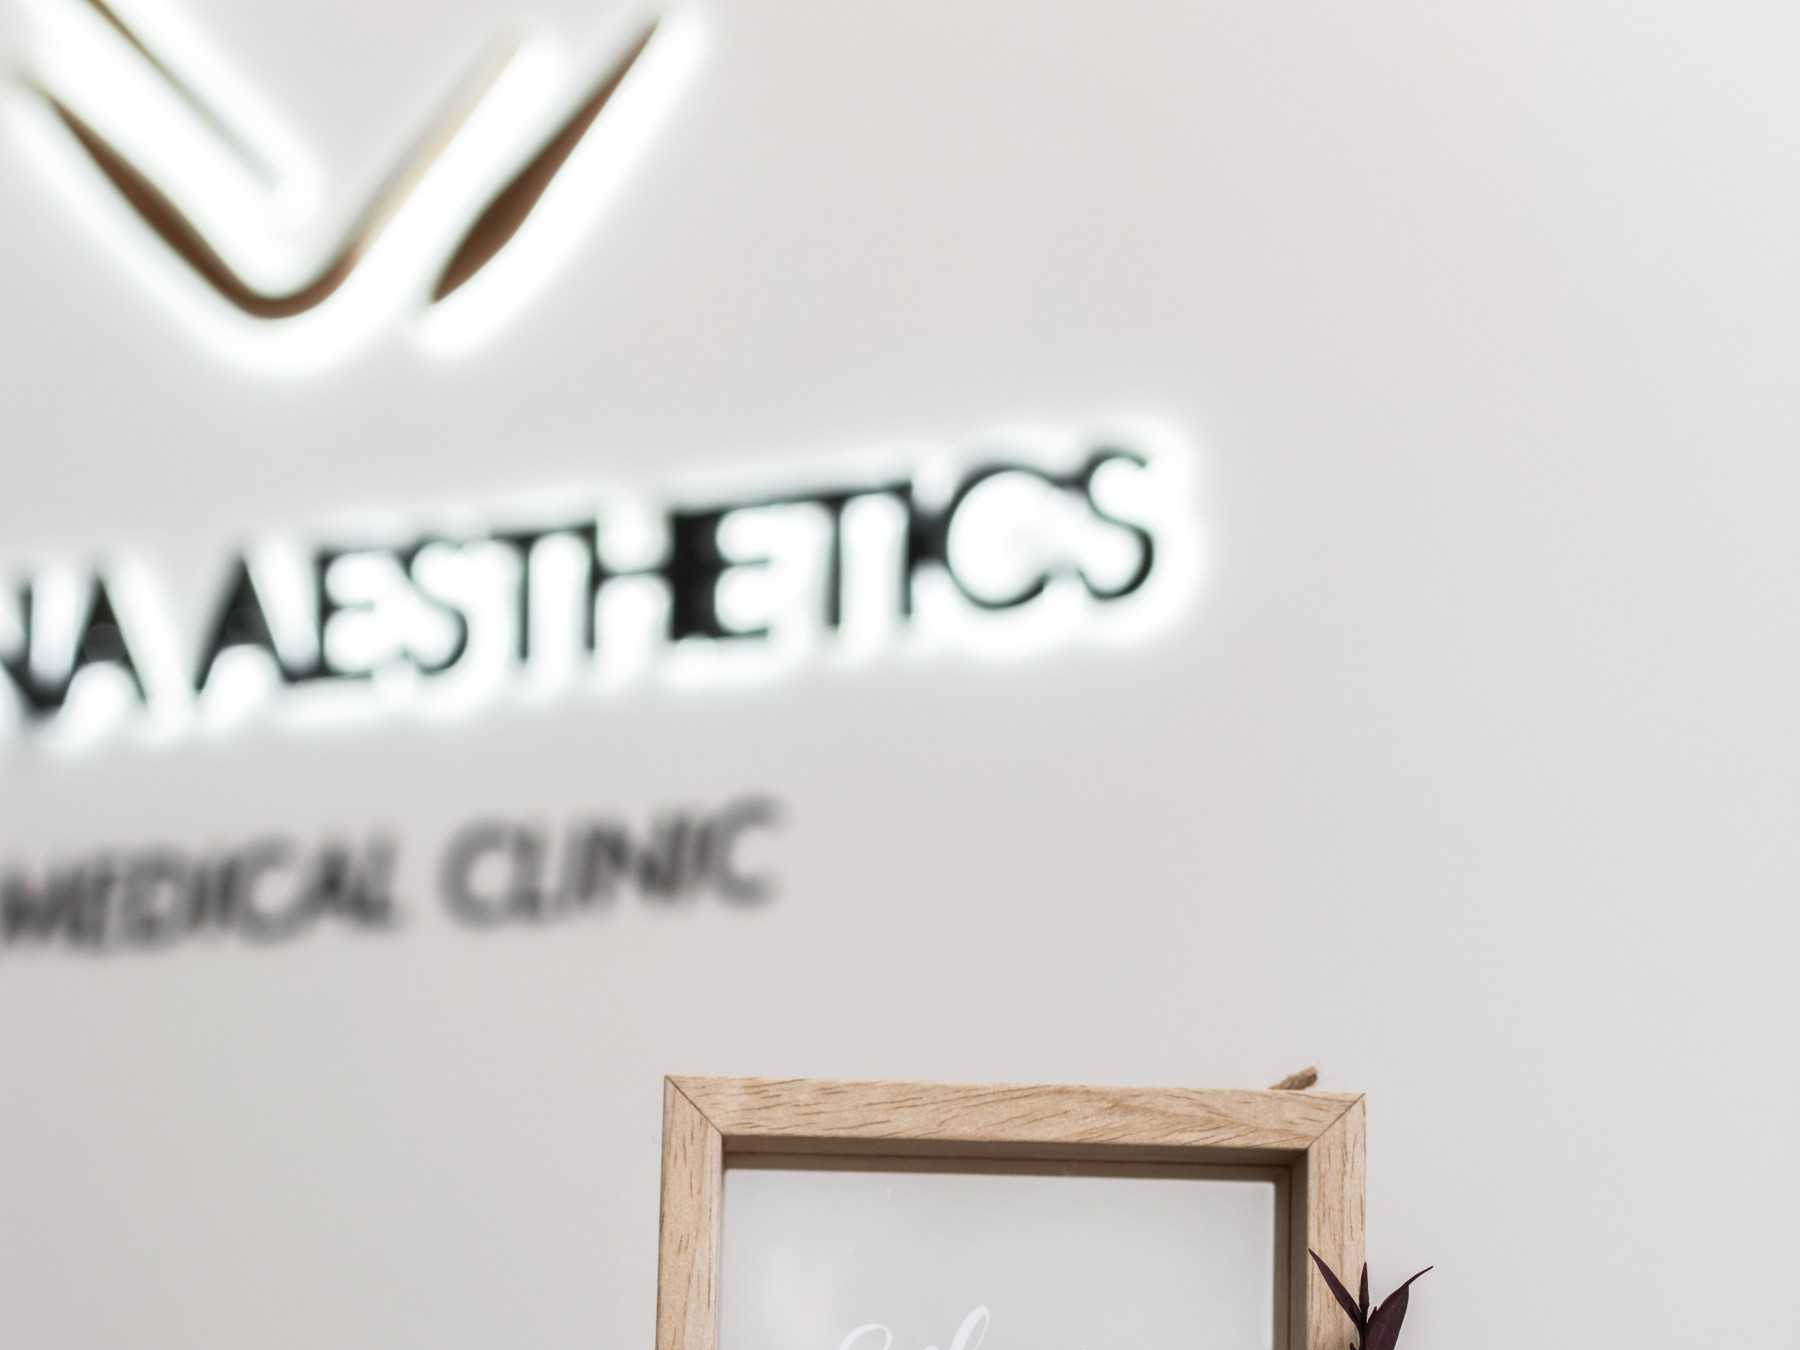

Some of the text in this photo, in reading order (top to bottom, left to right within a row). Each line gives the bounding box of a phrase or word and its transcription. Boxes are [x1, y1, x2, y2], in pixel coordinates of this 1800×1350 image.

[194, 449, 1156, 694] AESTHETICS
[0, 797, 782, 950] MEDICAL CLINIC
